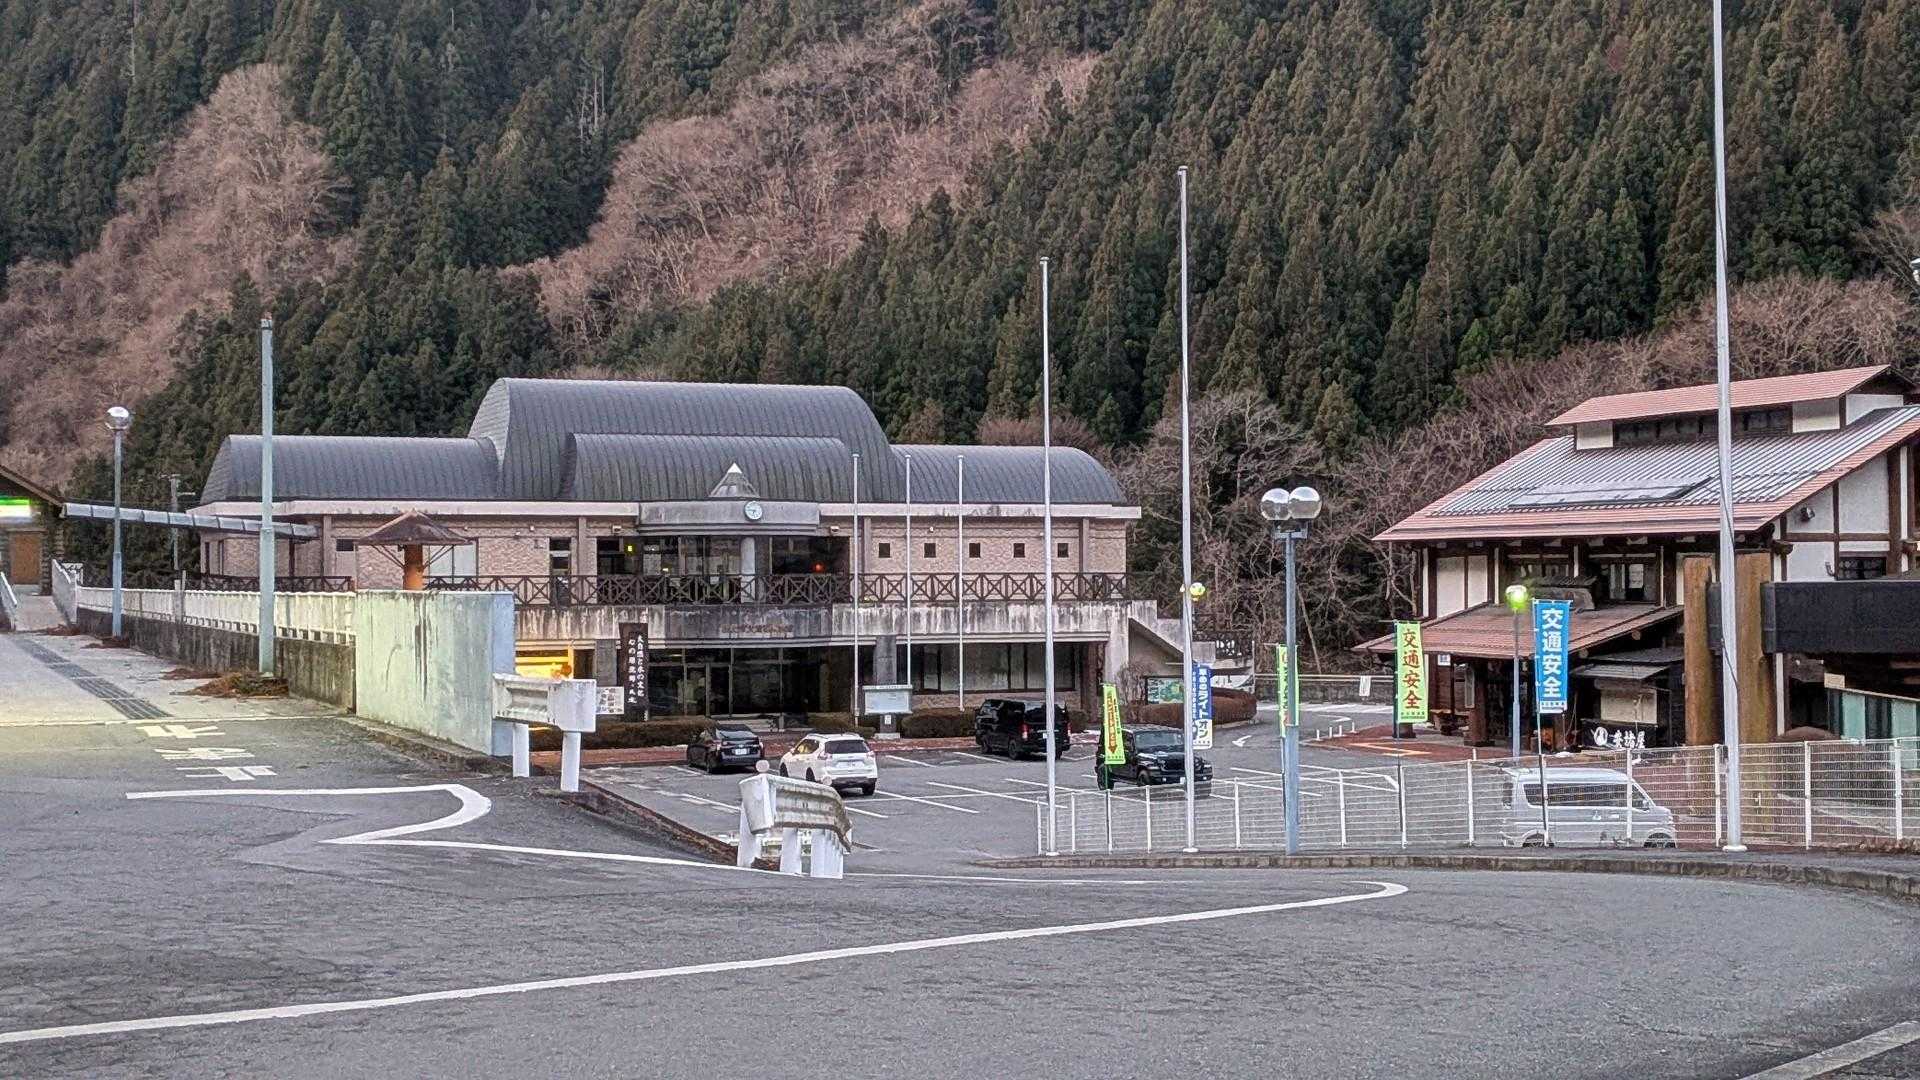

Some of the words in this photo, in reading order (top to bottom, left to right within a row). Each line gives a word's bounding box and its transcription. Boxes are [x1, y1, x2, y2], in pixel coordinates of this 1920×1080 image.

[1403, 629, 1421, 709] 交通安全
[1541, 607, 1563, 697] 交通安全
